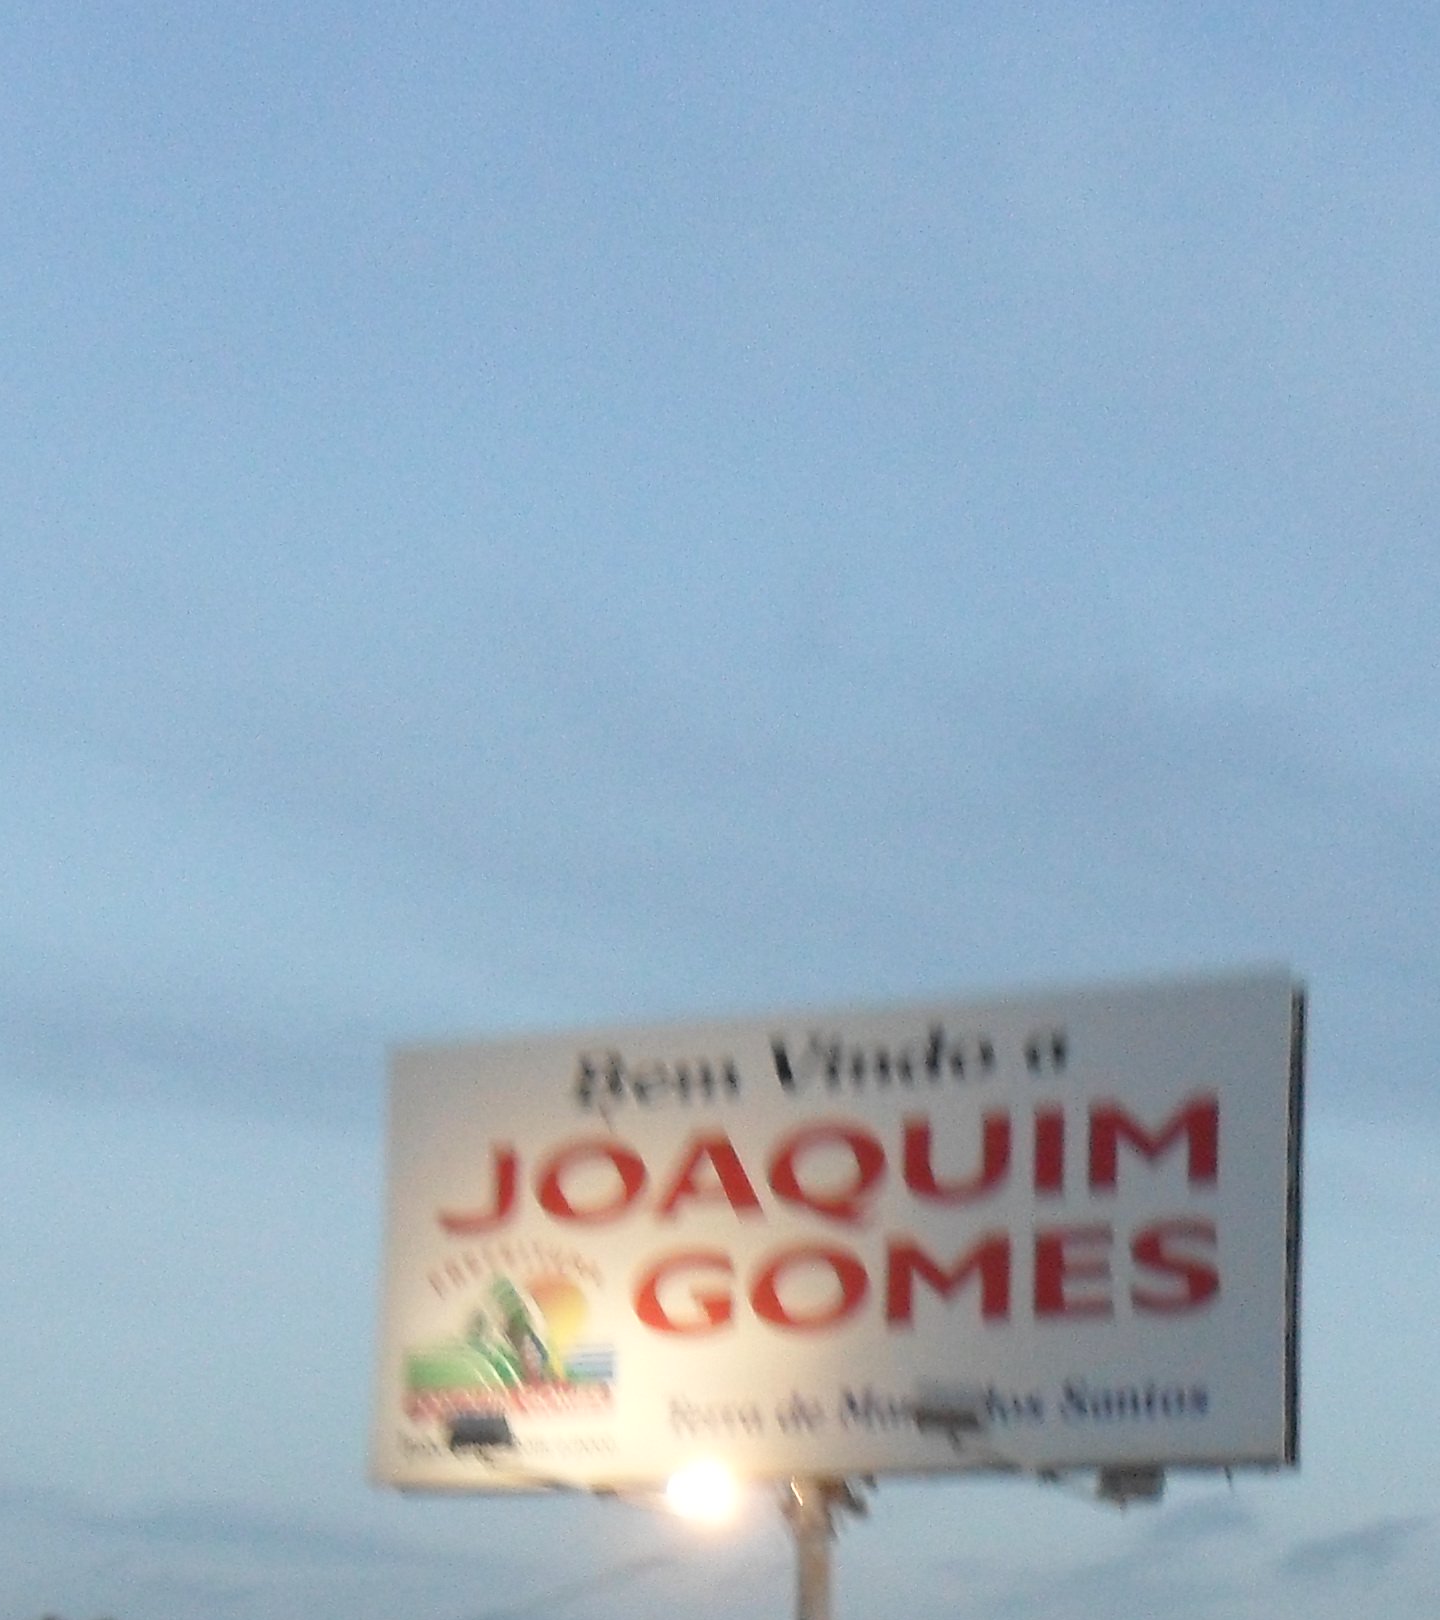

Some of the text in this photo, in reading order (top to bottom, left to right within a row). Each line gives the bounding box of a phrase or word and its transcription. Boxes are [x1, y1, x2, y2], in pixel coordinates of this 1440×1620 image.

[575, 1047, 740, 1108] Bem
[768, 1022, 996, 1095] Vindo
[437, 1088, 1221, 1239] JOAQUIM
[632, 1215, 1221, 1341] GOMES
[1060, 1378, 1208, 1422] Santos
